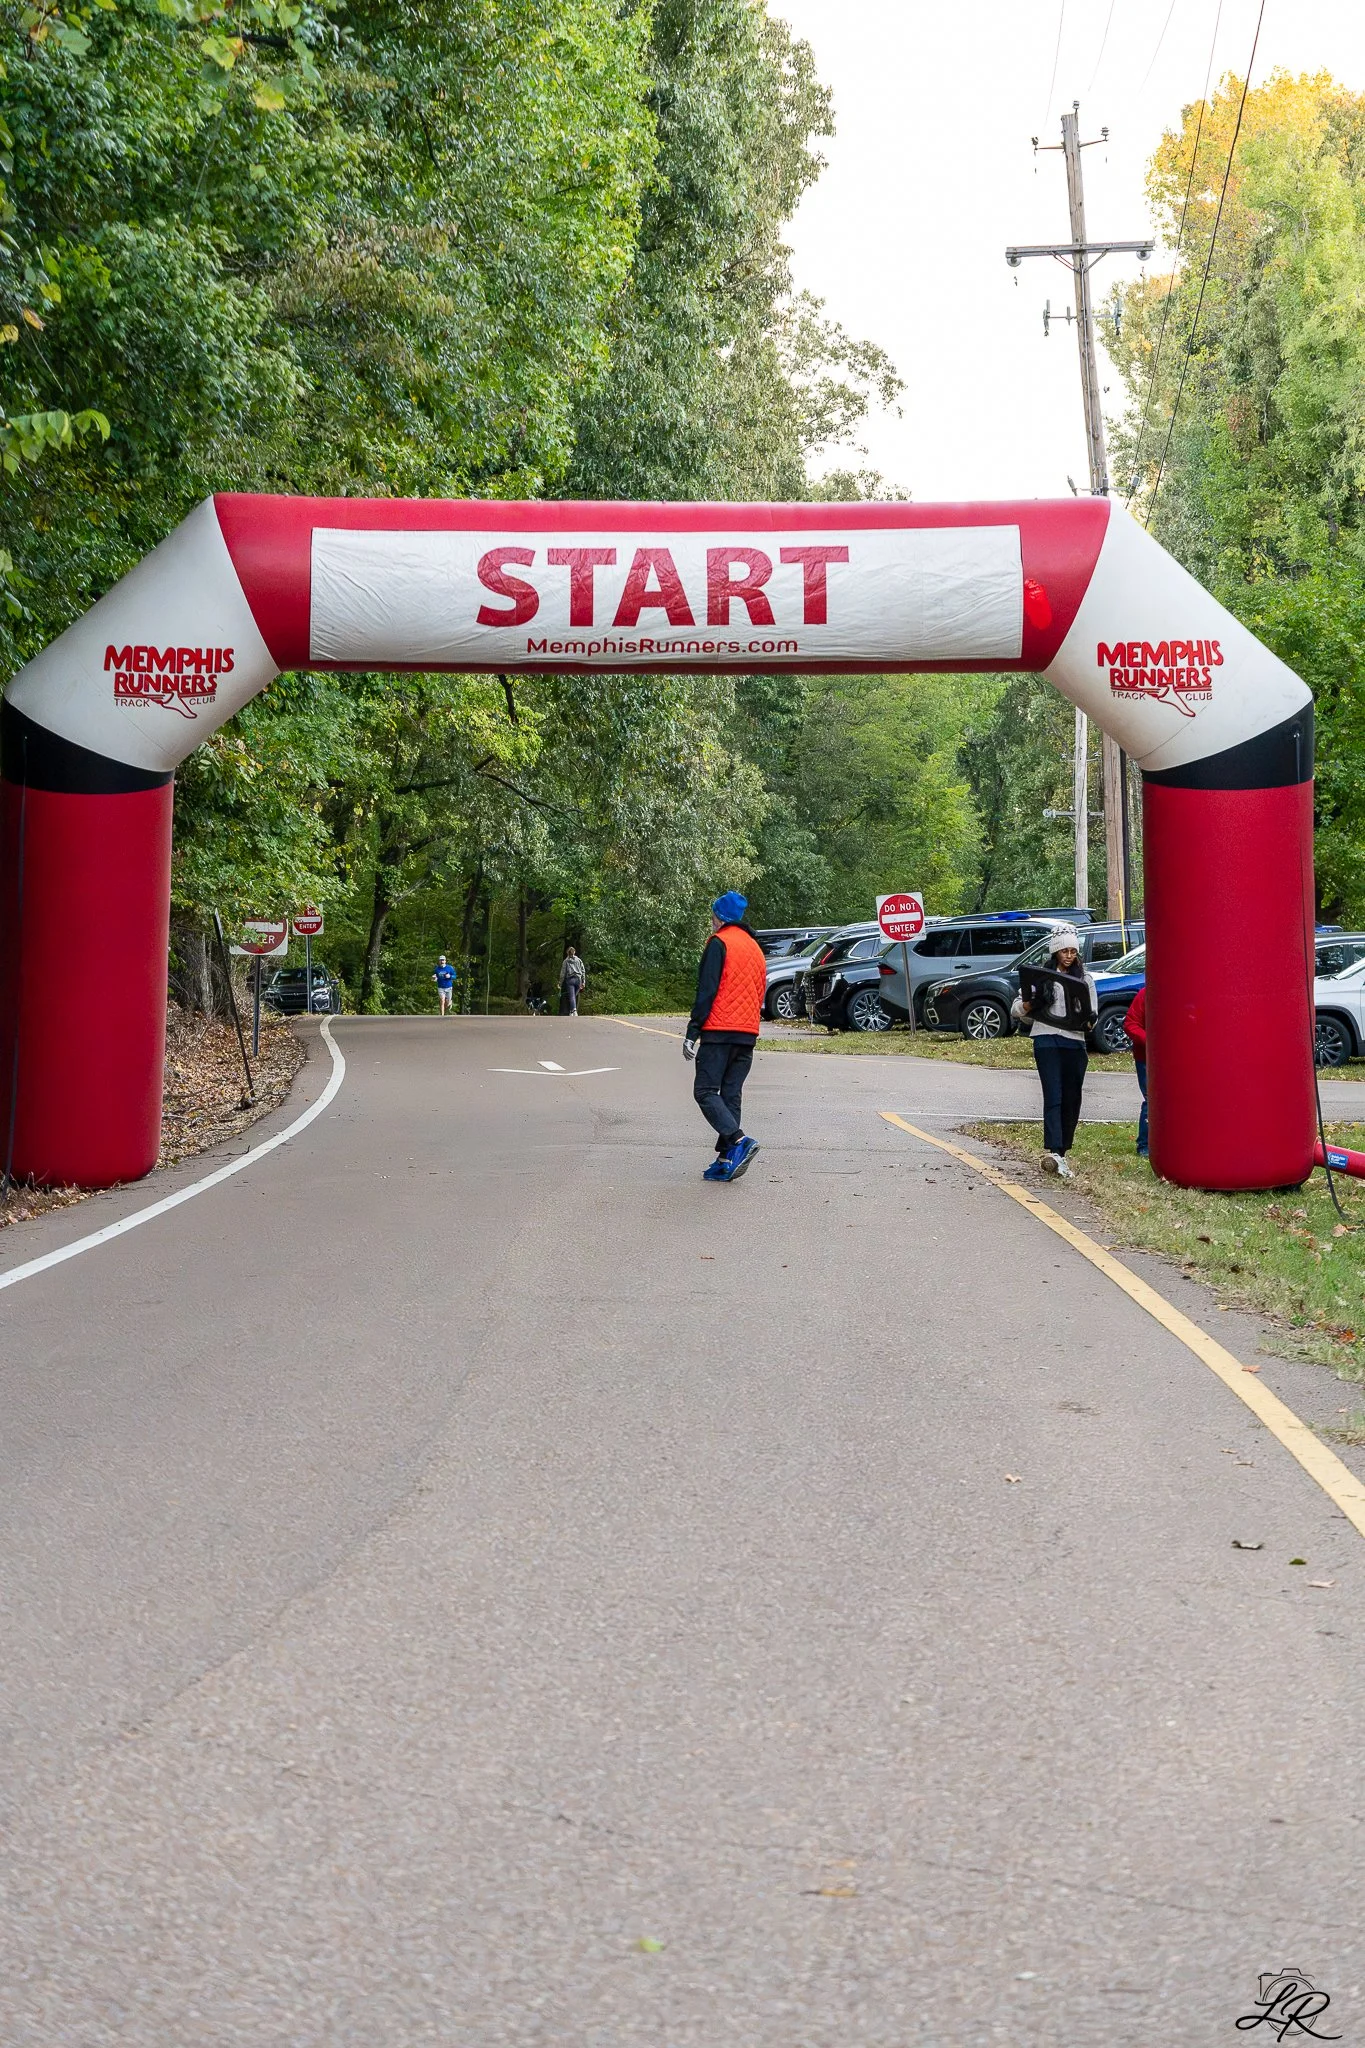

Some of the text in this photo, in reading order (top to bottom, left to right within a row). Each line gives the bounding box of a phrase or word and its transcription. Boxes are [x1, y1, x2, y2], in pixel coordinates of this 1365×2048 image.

[475, 546, 850, 627] START
[527, 637, 799, 657] MemphisRunners.com
[1097, 639, 1225, 668] MEMPHIS
[103, 644, 236, 674] MEMPHIS
[113, 671, 218, 694] RUNNERS
[1109, 666, 1213, 687] RUNNERS
[114, 695, 217, 708] TRACK CLUB
[1111, 690, 1213, 701] TRACK CLUB
[884, 902, 916, 912] DO NOT
[889, 923, 916, 933] ENTER
